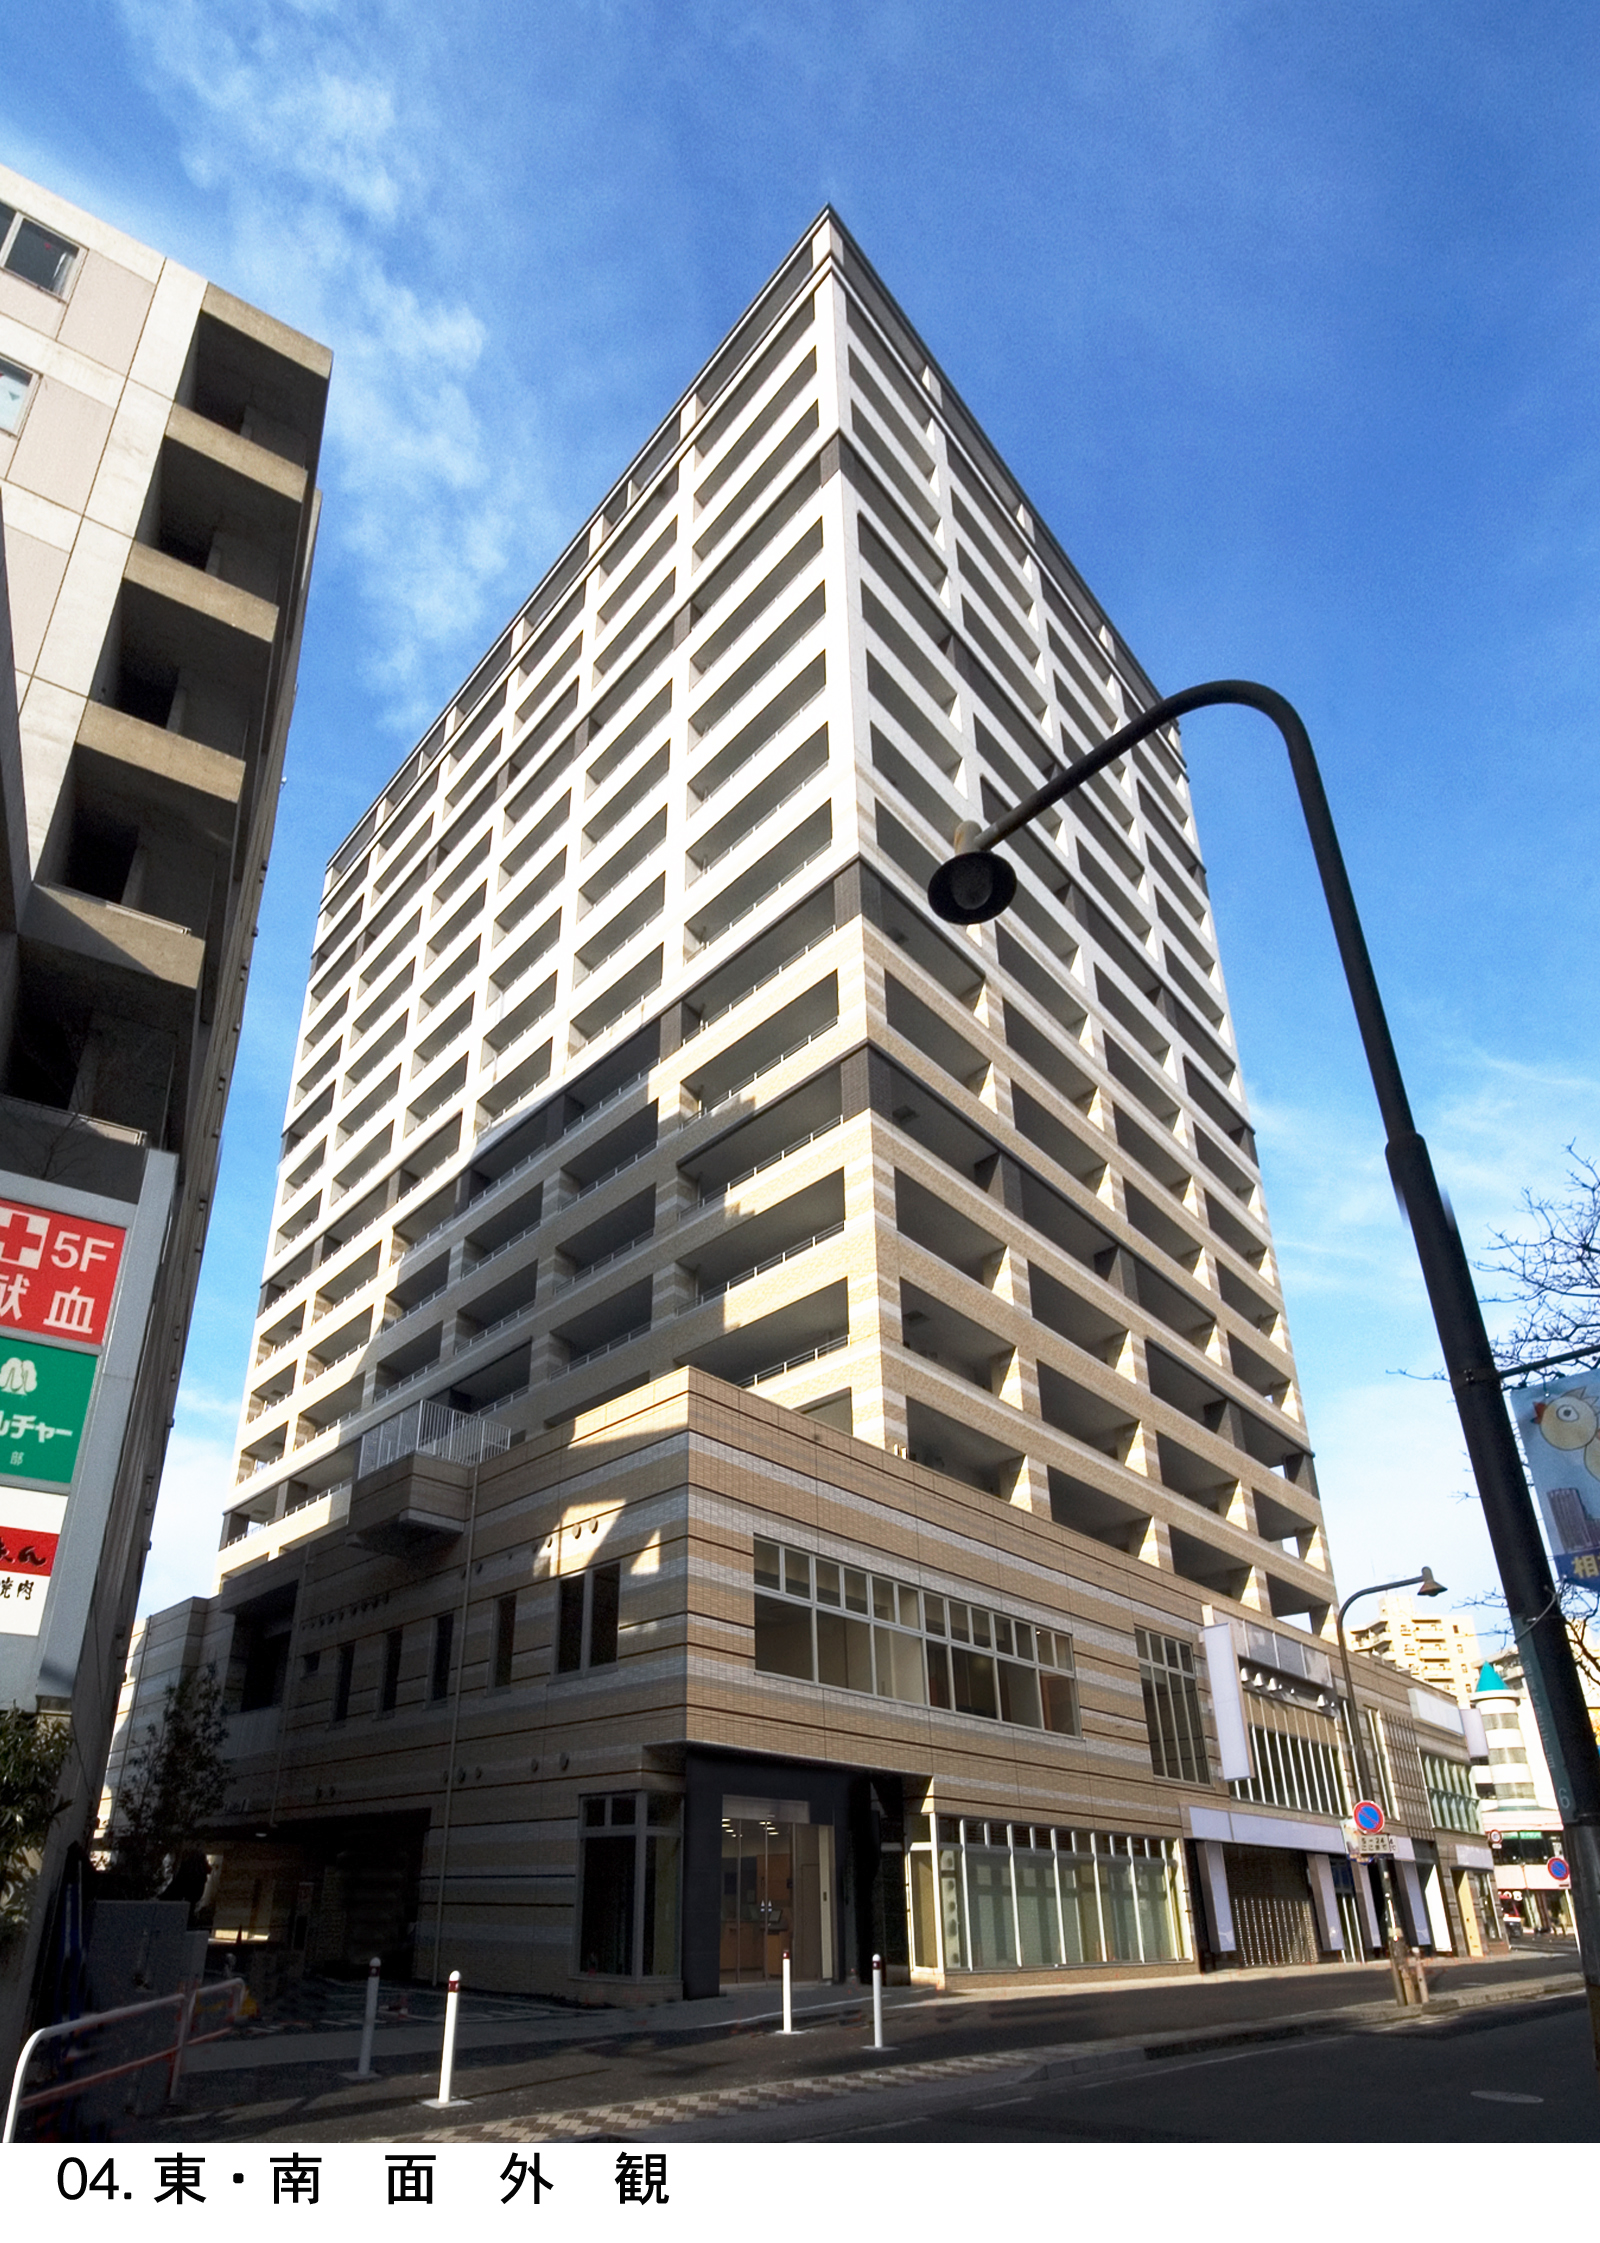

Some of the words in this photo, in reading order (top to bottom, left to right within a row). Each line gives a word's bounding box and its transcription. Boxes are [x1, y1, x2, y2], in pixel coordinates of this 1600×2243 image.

[51, 1230, 115, 1272] 5F
[1571, 1554, 1600, 1579] 相
[1558, 1787, 1571, 1809] 6
